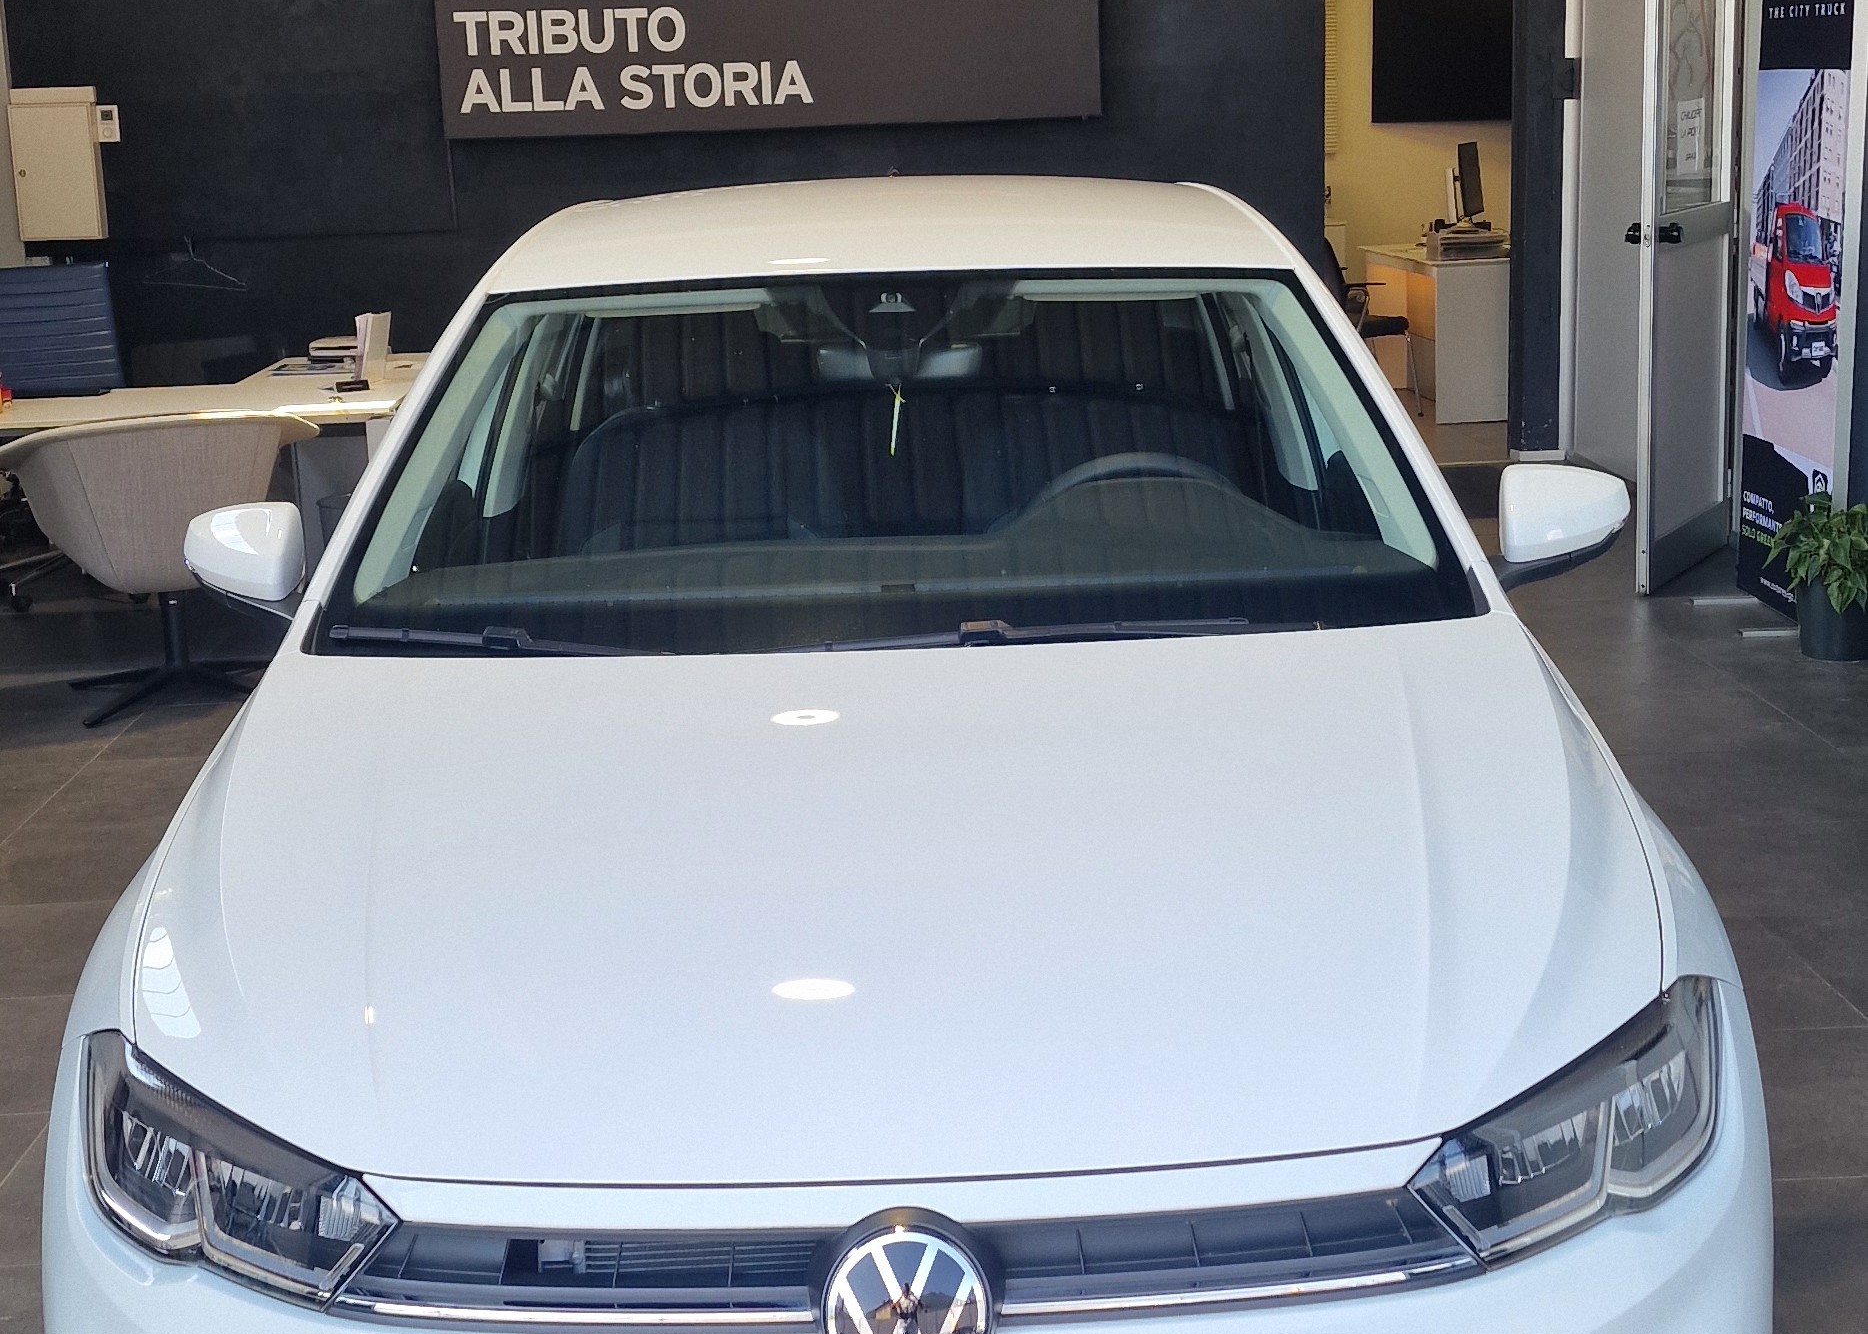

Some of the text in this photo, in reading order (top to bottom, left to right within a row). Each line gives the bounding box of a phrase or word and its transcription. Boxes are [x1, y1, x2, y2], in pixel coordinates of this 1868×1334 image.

[1769, 3, 1846, 19] THE CITY TRUCK
[452, 6, 687, 56] TRIBUTO
[460, 60, 814, 114] ALLA STORIA
[1743, 490, 1775, 515] COMPATTO,
